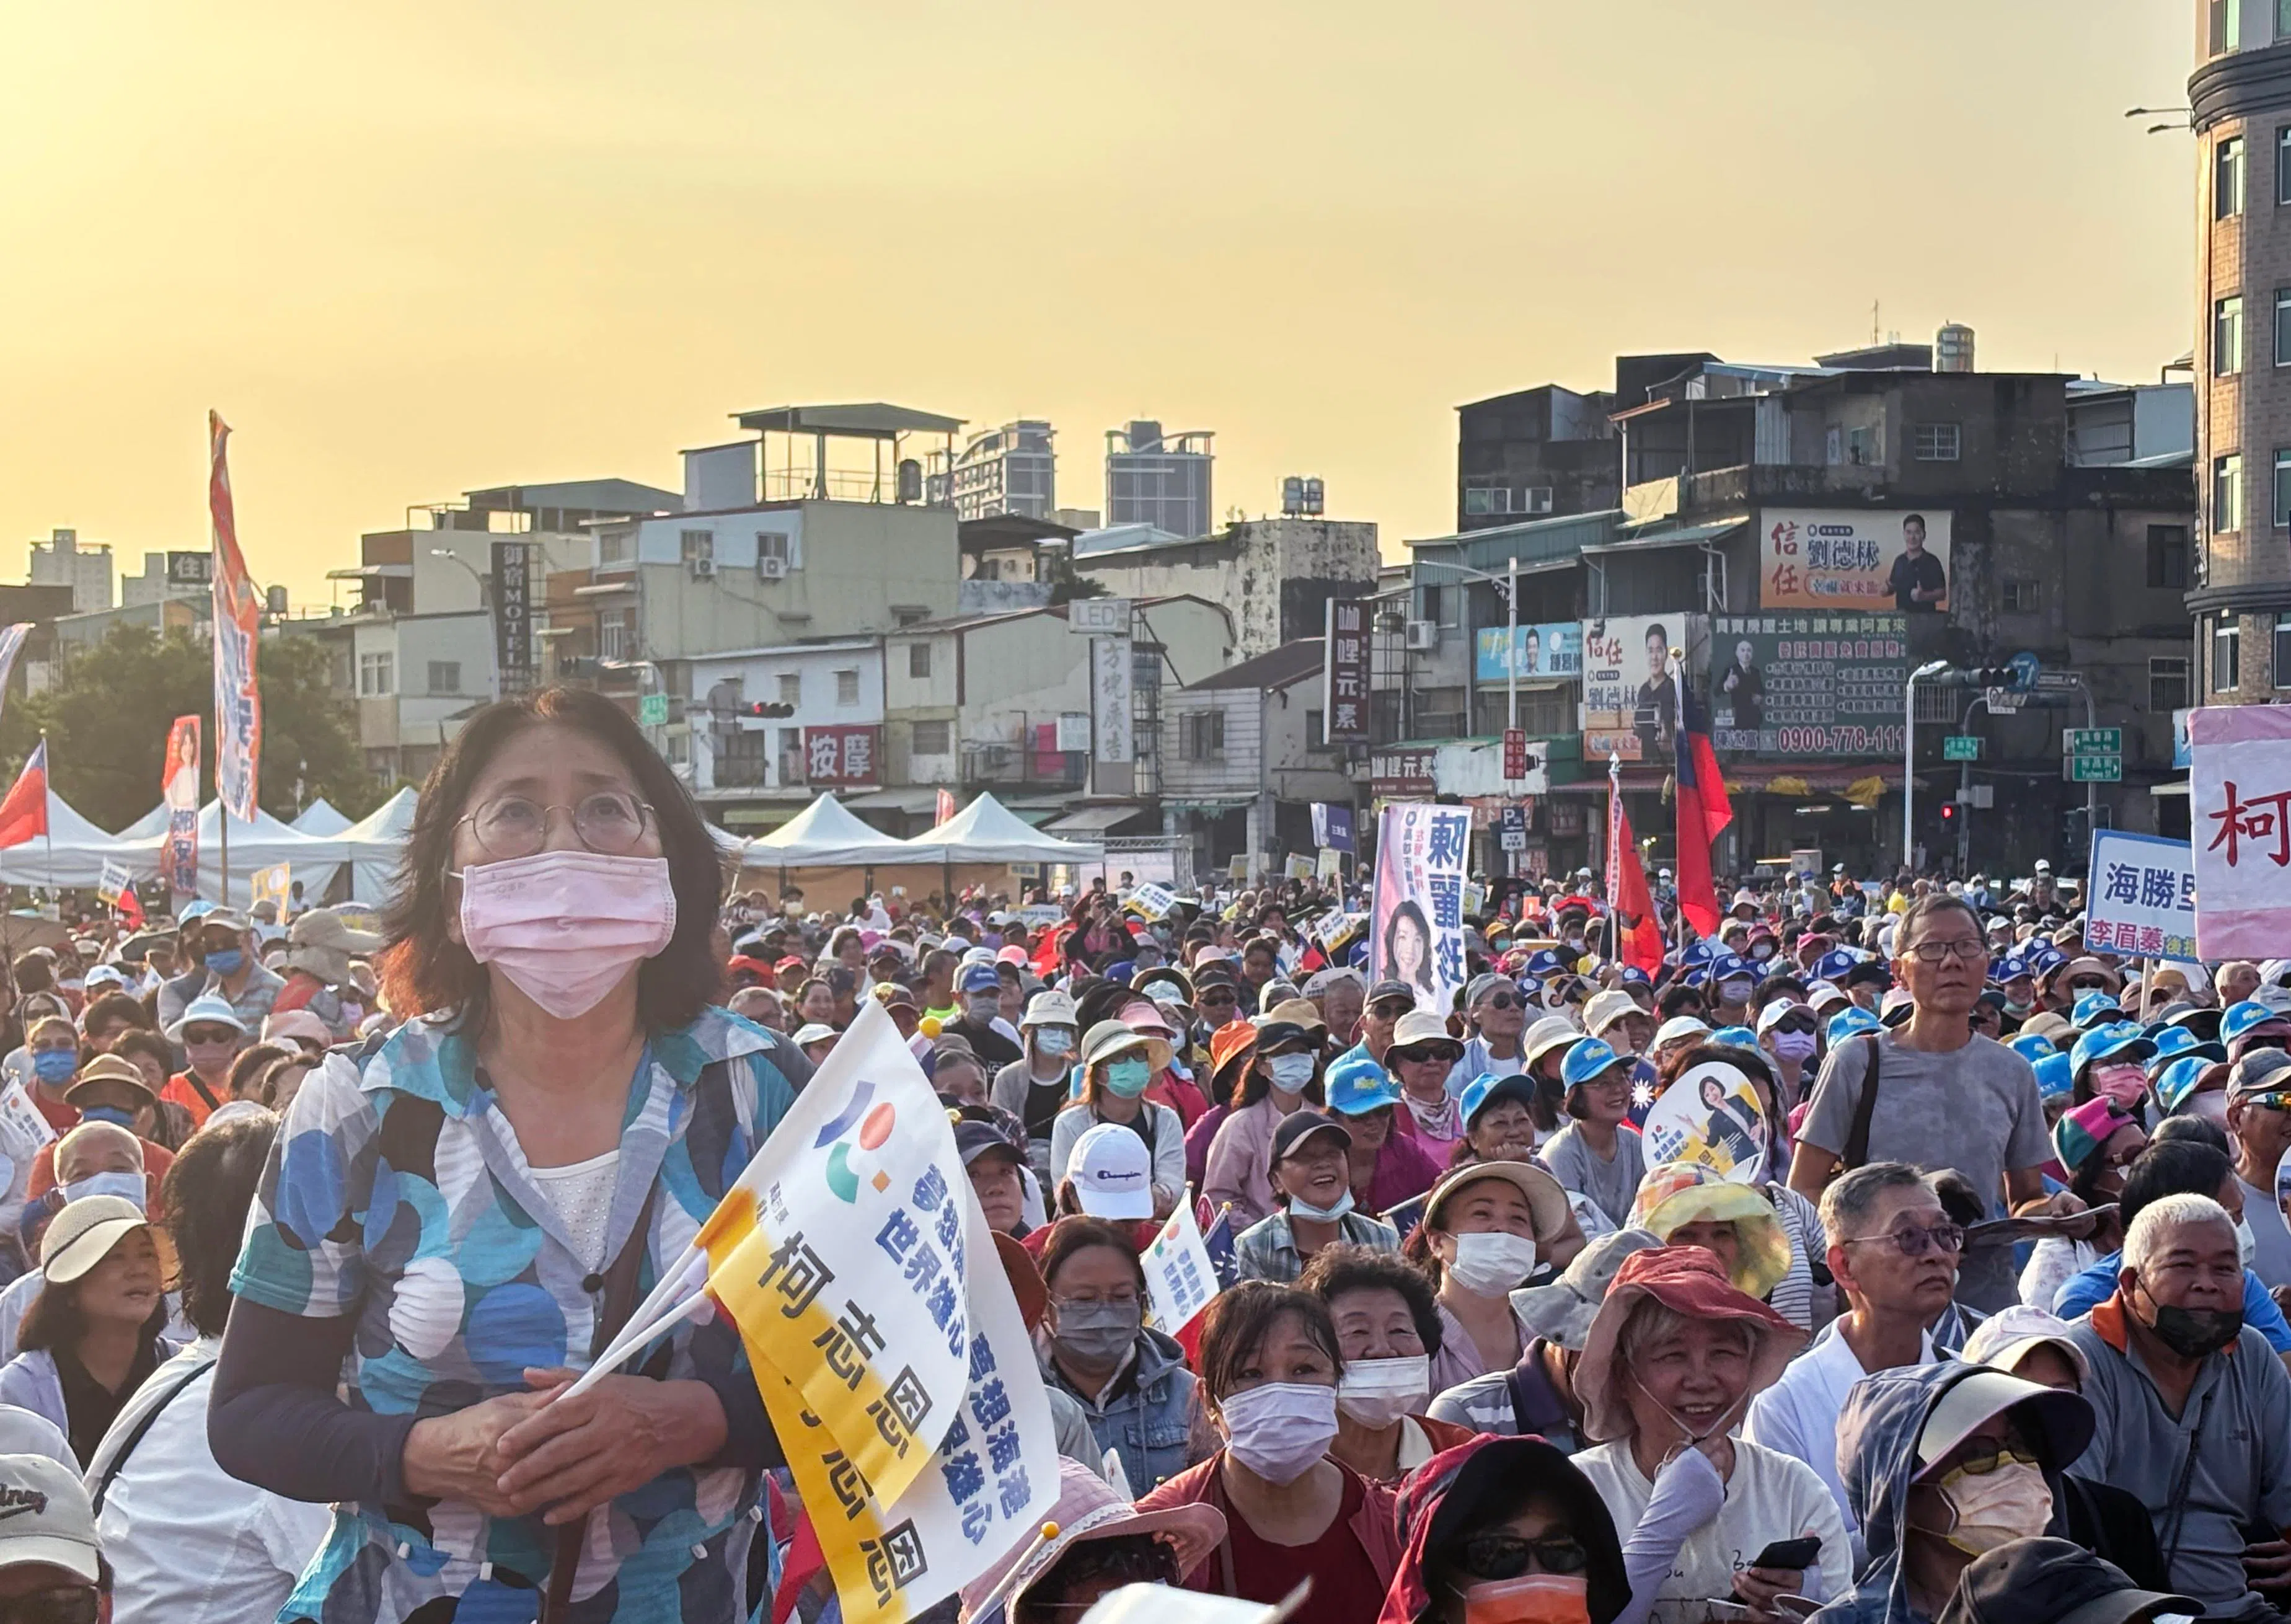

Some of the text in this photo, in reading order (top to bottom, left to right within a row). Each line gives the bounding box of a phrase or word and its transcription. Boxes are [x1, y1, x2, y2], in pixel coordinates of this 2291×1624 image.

[1771, 521, 1799, 596] 信任
[1807, 539, 1880, 571] 劉德林
[1076, 604, 1115, 626] LED
[1335, 605, 1360, 730] 咖哩元素
[810, 734, 871, 779] 按摩
[1371, 756, 1437, 779] 咖哩元素
[1778, 724, 1906, 752] 0900-778-111
[1503, 808, 1516, 825] P
[2207, 780, 2291, 868] 柯
[1097, 1169, 1142, 1181] Champion
[912, 1162, 965, 1295] 夢想海
[875, 1207, 965, 1359] 世界雄心
[757, 1230, 934, 1459] 柯志恩
[937, 1411, 992, 1547] 界雄心
